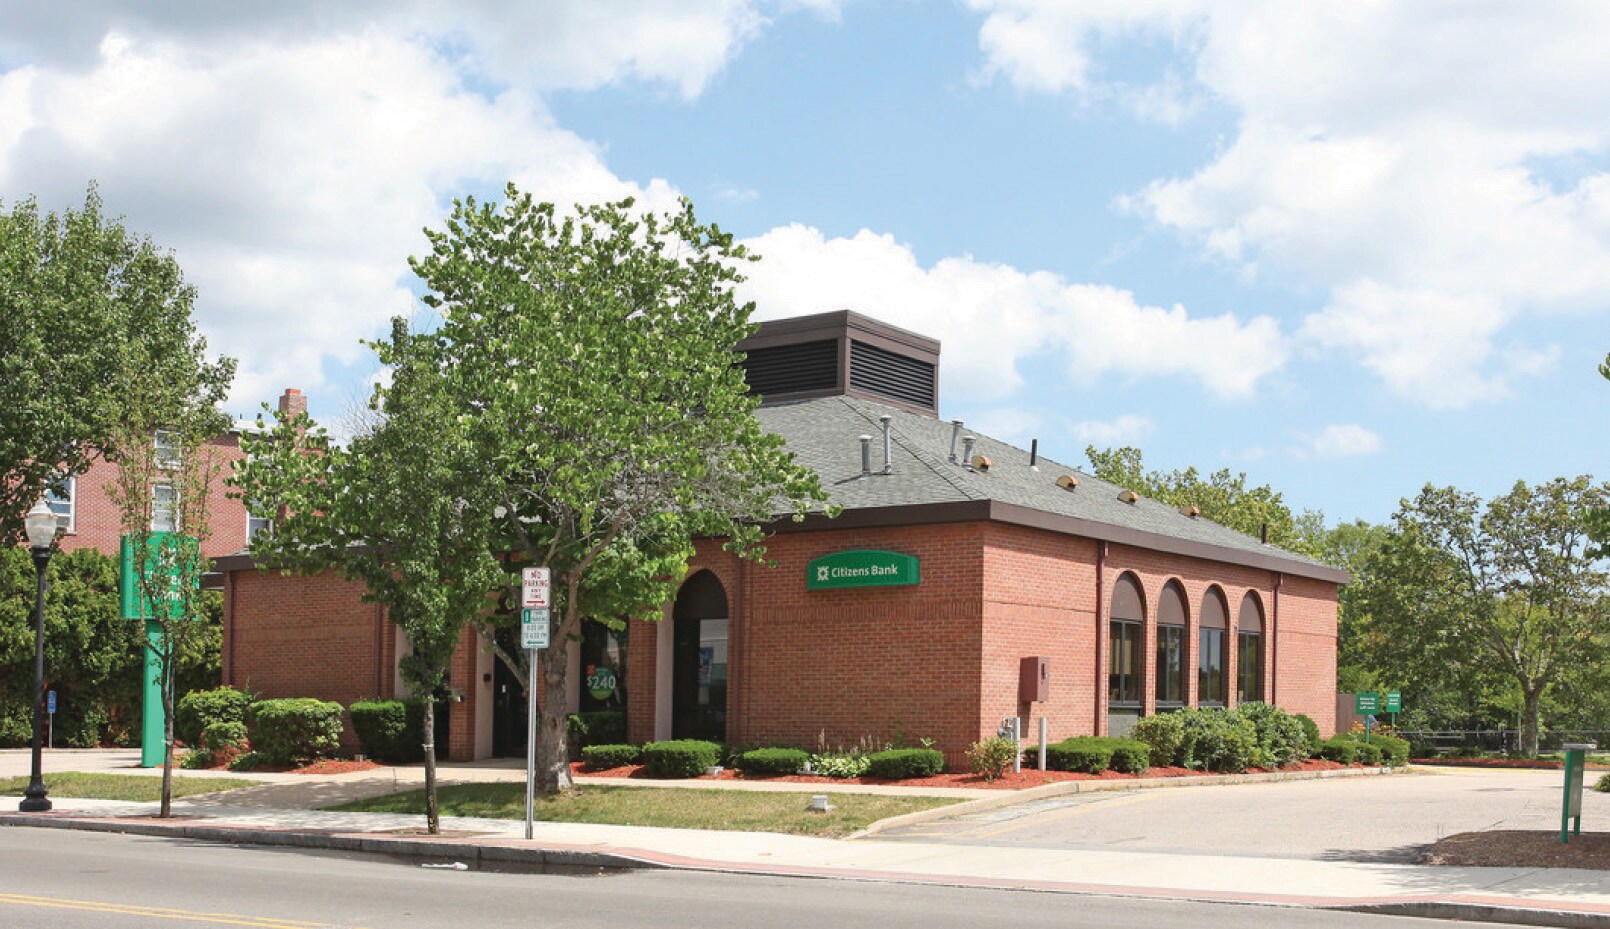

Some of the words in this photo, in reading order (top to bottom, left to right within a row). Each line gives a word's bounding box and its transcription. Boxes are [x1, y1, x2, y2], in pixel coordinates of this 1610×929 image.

[531, 570, 542, 579] NO
[831, 566, 869, 578] Citizens
[870, 563, 898, 576] Bank
[523, 579, 549, 588] PARKING
[587, 675, 616, 690] $240
